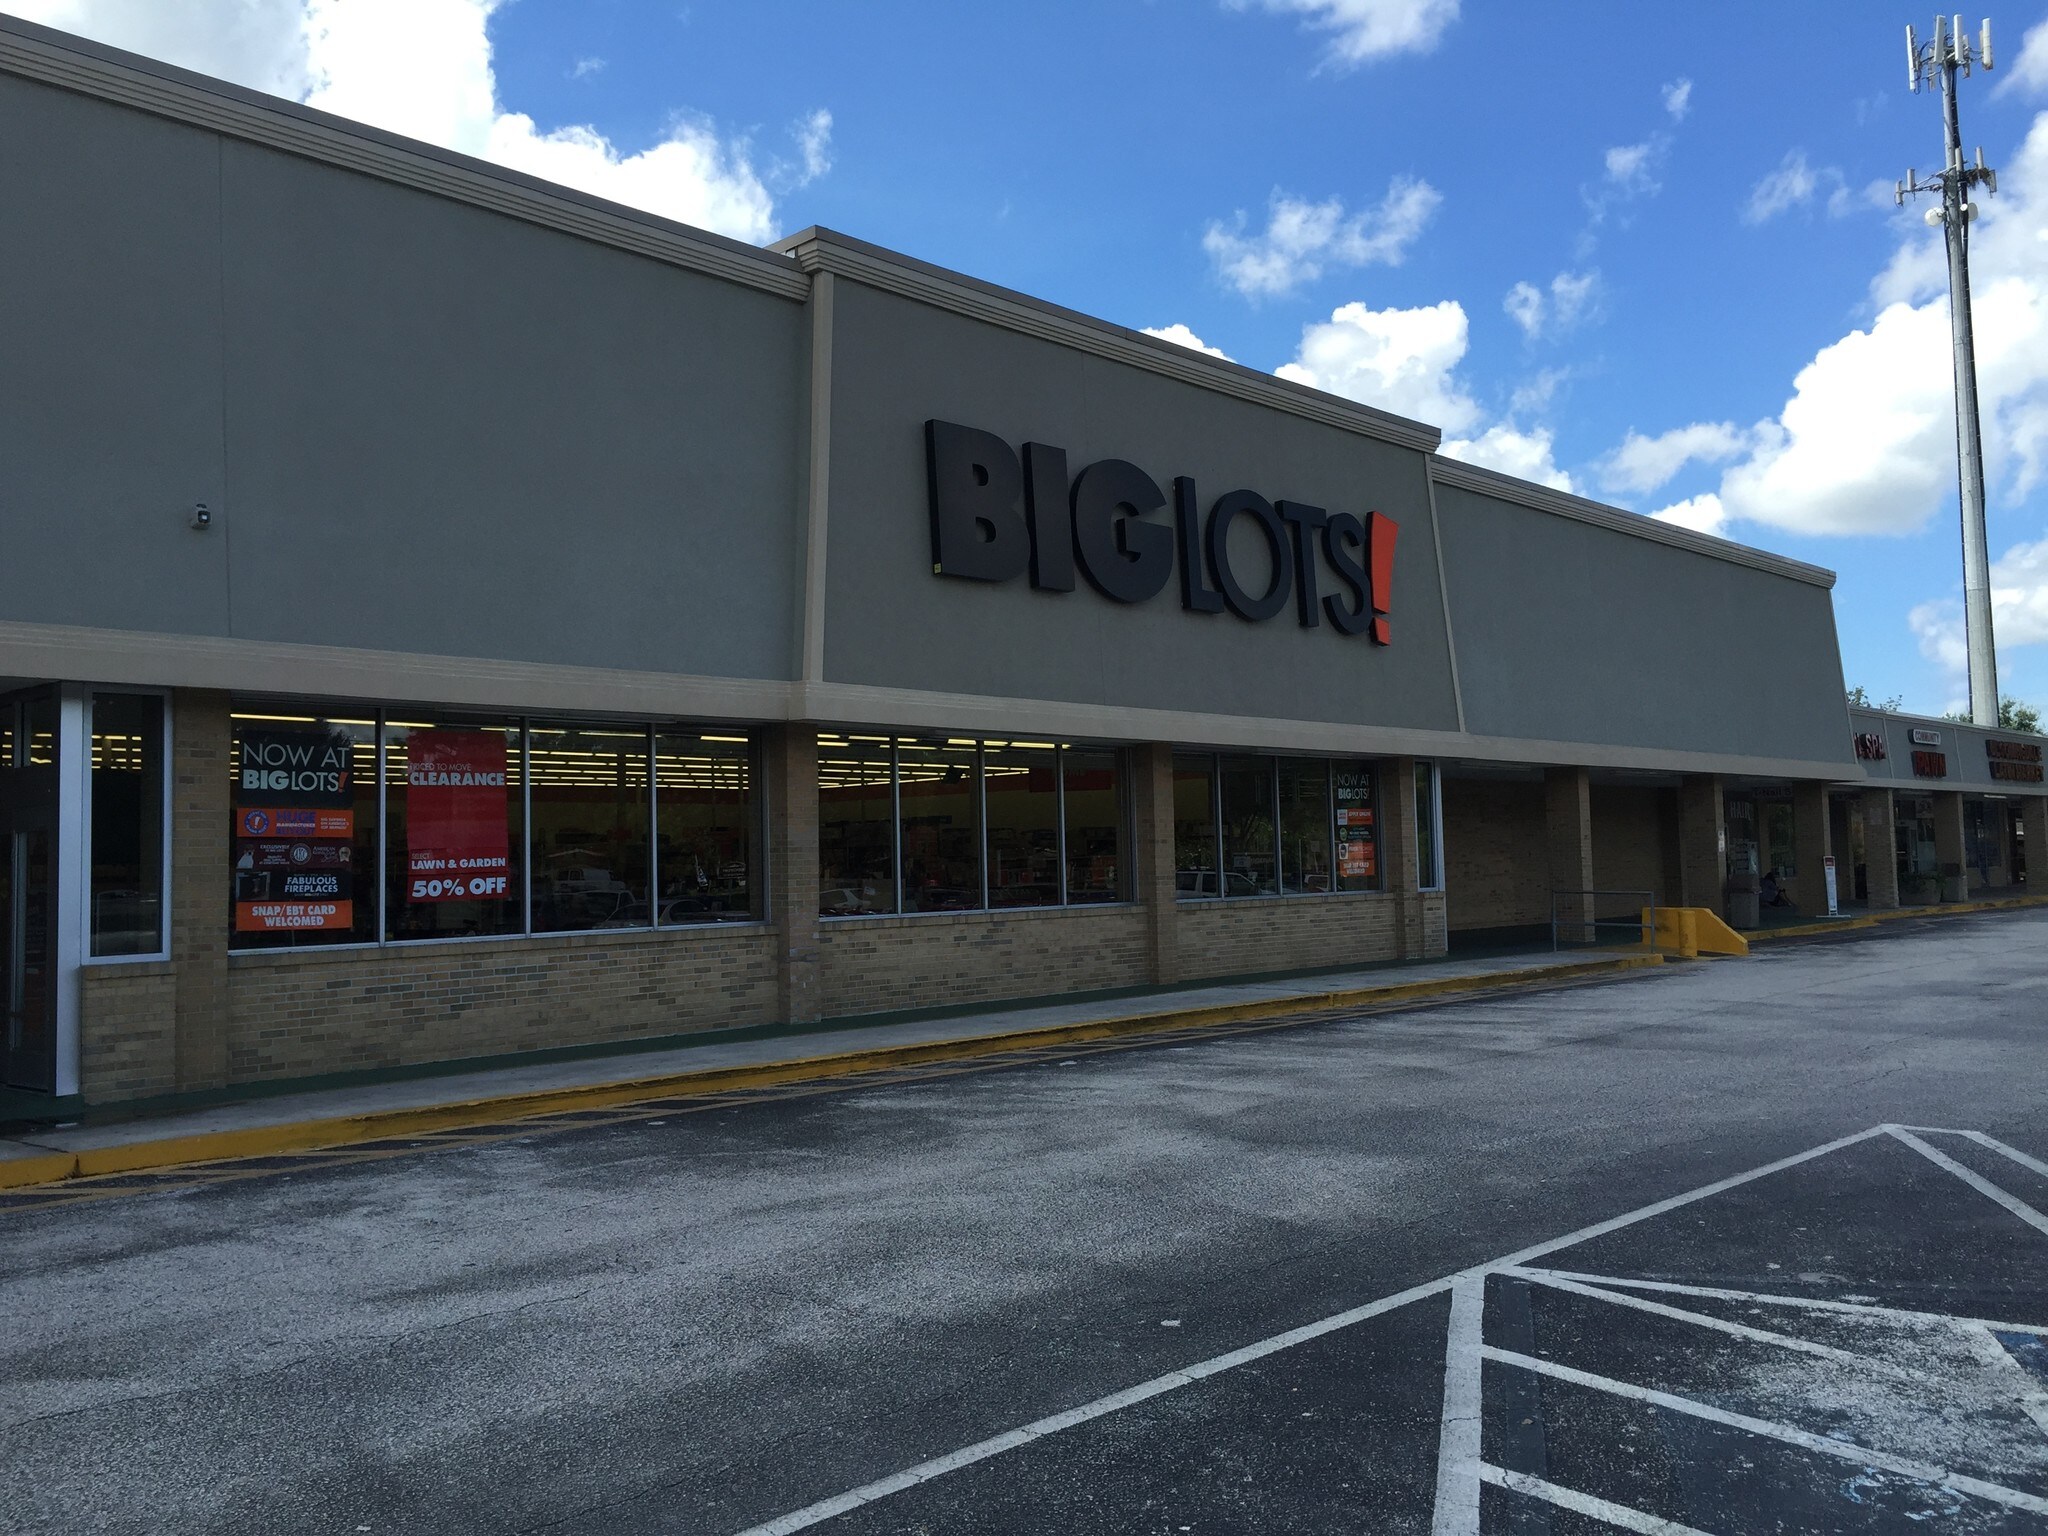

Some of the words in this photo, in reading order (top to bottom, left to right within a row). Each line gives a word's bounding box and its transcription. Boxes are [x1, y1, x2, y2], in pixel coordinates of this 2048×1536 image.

[925, 420, 1173, 603] BIG
[1174, 476, 1399, 645] LOTS!
[243, 742, 314, 767] NOW
[320, 746, 350, 768] AT
[436, 763, 447, 771] TO
[448, 763, 472, 771] MOVE
[1913, 751, 1946, 778] PAWN
[243, 769, 290, 790] BIG
[291, 771, 350, 793] LOTS!
[409, 772, 505, 786] CLEARANCE
[1337, 774, 1358, 786] NOW
[1360, 774, 1370, 786] AT
[1337, 788, 1351, 799] BIG
[1730, 801, 1752, 822] HAIR
[411, 860, 445, 870] LAWN
[447, 859, 457, 868] &
[459, 858, 506, 868] GARDEN
[286, 876, 337, 885] FABULOUS
[284, 884, 338, 893] FIREPLACES
[412, 878, 465, 897] 50%
[469, 877, 507, 895] OFF
[251, 904, 304, 916] SNAP/EBT
[307, 904, 336, 915] CARD
[264, 916, 324, 927] WELCOMED
